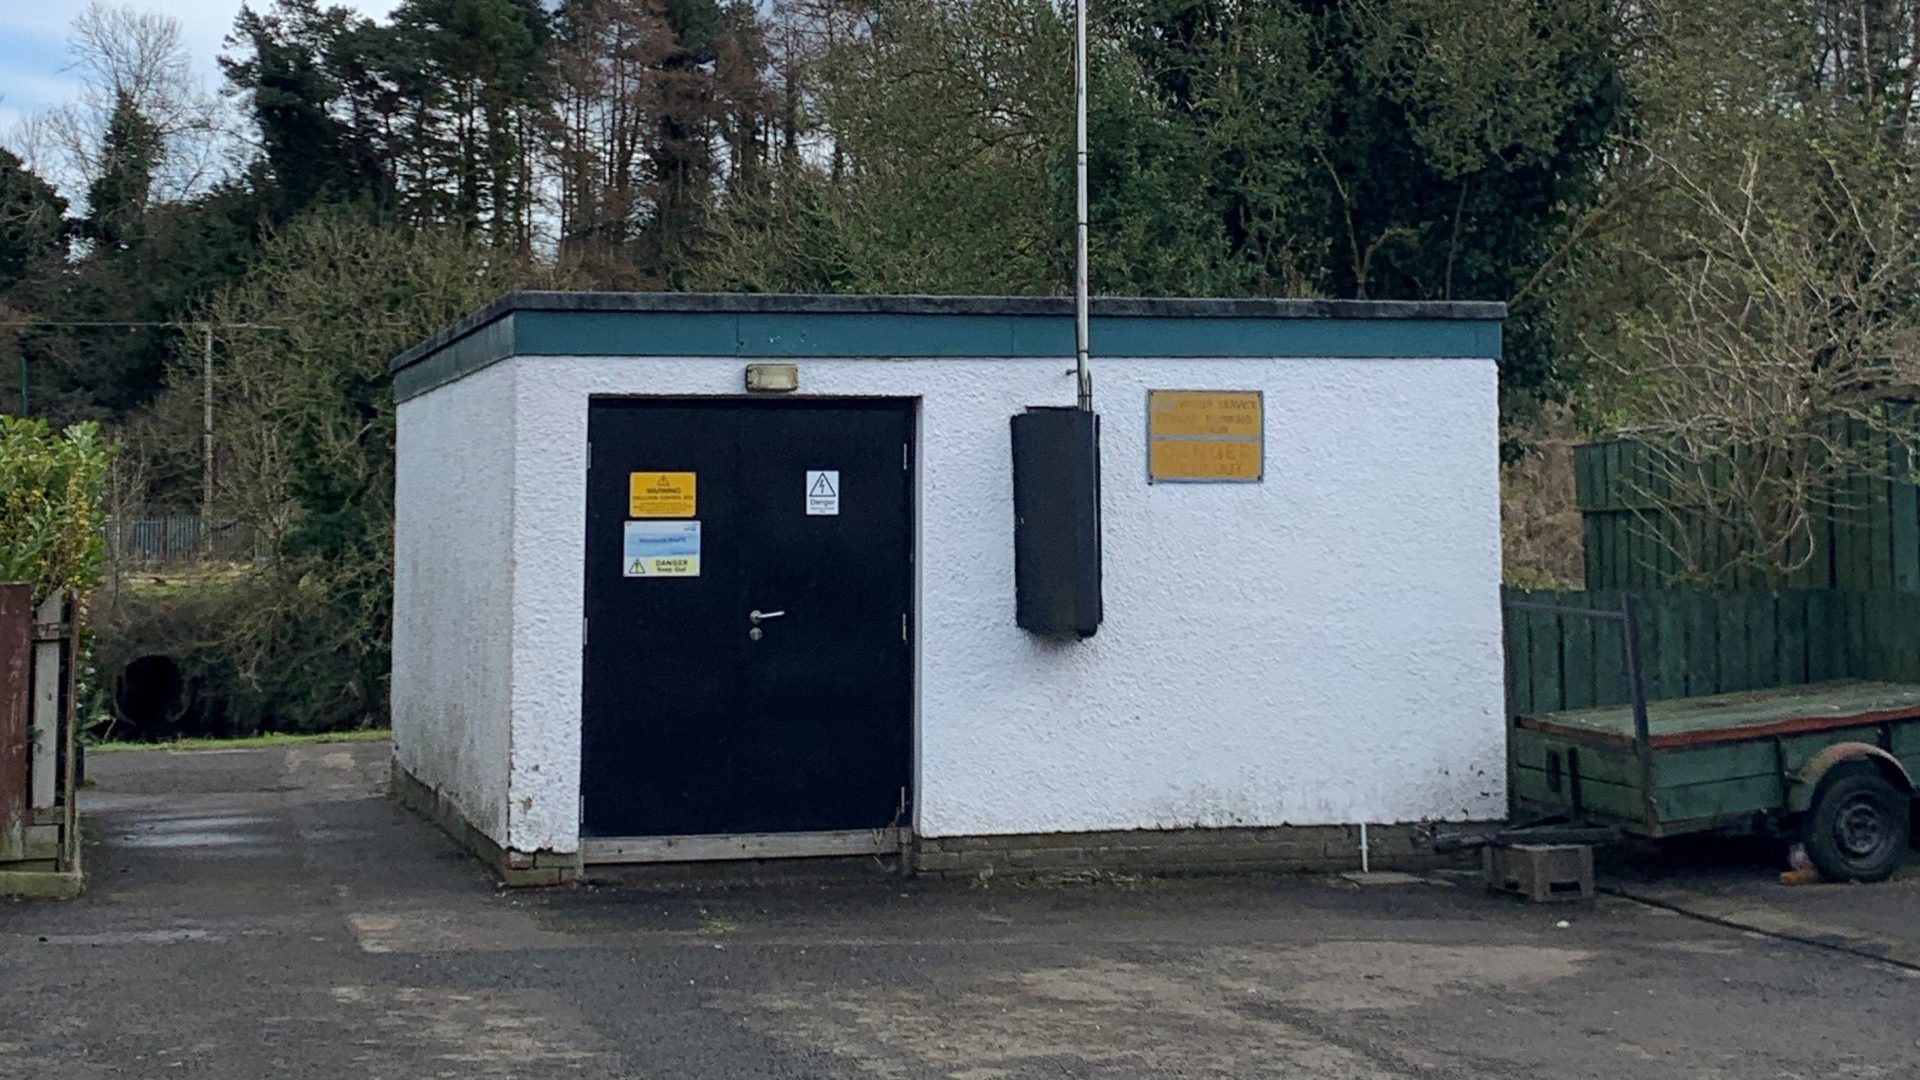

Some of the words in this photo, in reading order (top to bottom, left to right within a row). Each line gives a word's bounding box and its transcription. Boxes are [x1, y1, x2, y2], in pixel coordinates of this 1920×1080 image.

[1217, 399, 1258, 410] SERVICE
[1160, 443, 1250, 461] DANGER
[645, 487, 682, 495] WARNING
[810, 499, 836, 507] Danger
[655, 559, 689, 567] DANGER
